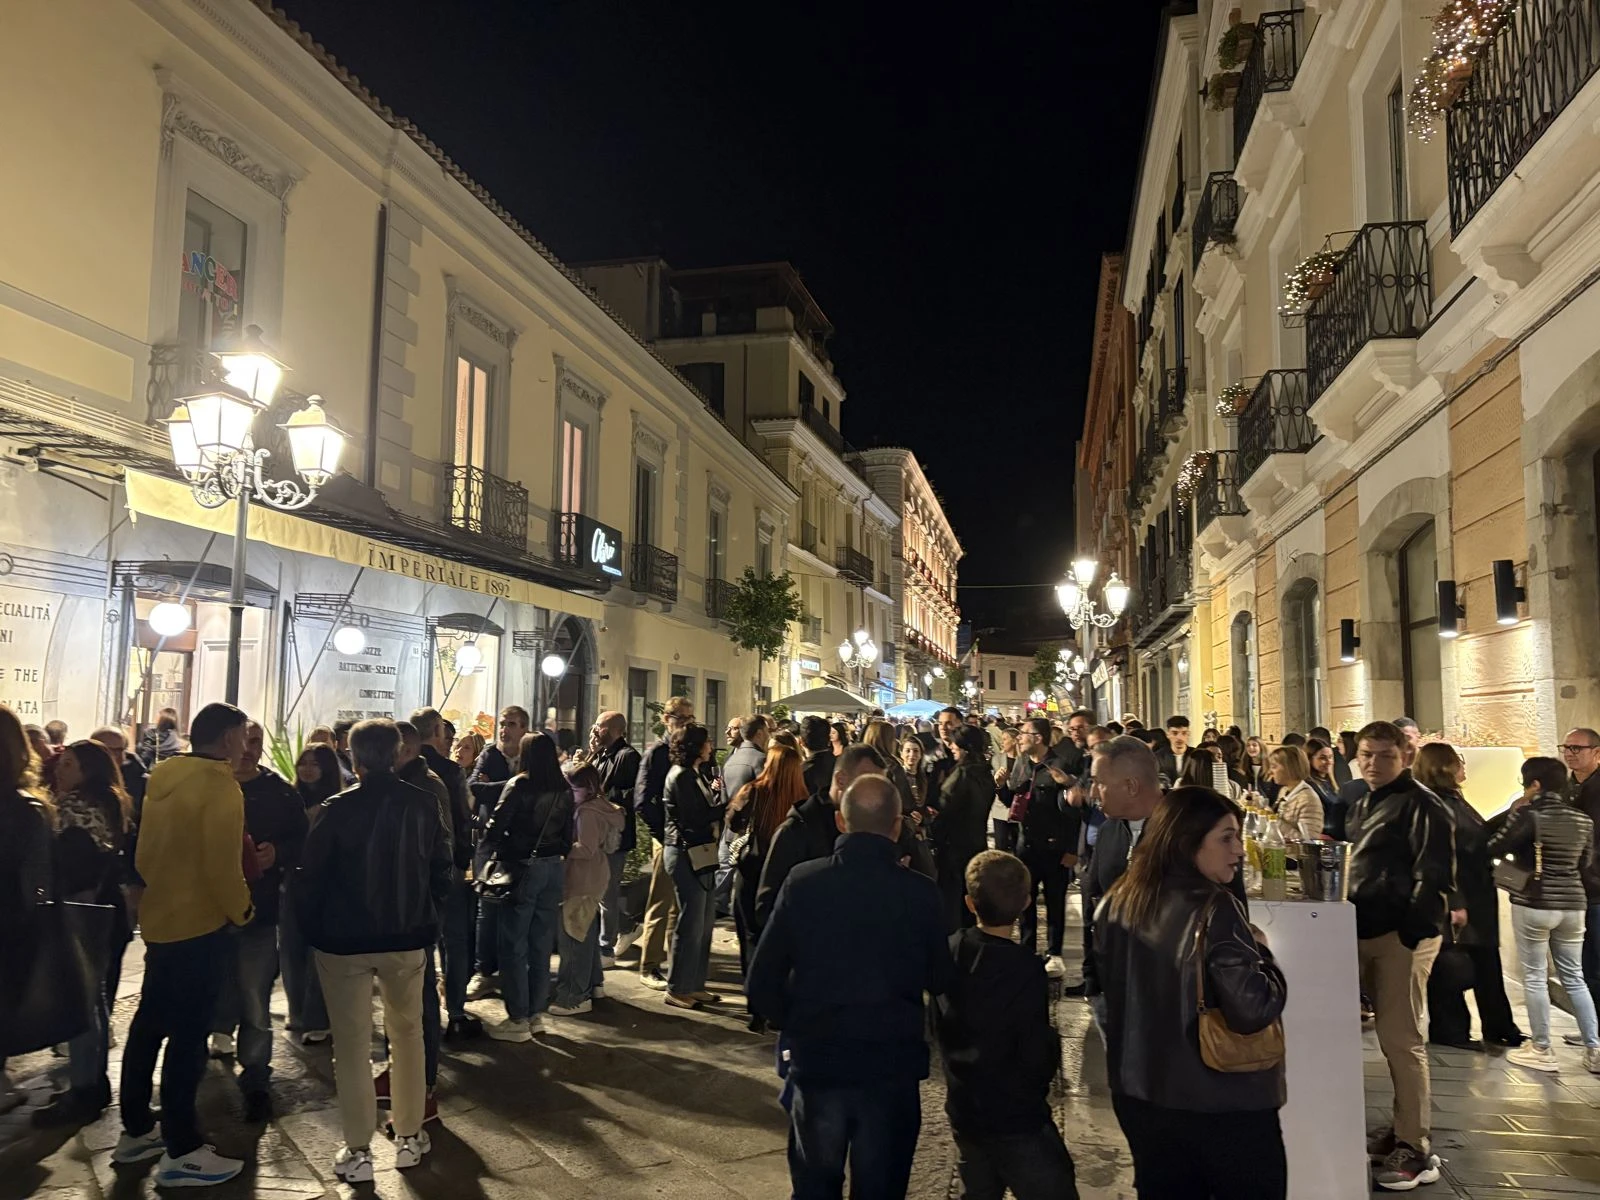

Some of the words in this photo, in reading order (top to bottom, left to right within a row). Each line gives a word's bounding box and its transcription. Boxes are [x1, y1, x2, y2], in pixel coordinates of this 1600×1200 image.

[368, 548, 479, 591] IMPERIALE
[485, 578, 511, 598] 1892
[14, 668, 39, 683] THE
